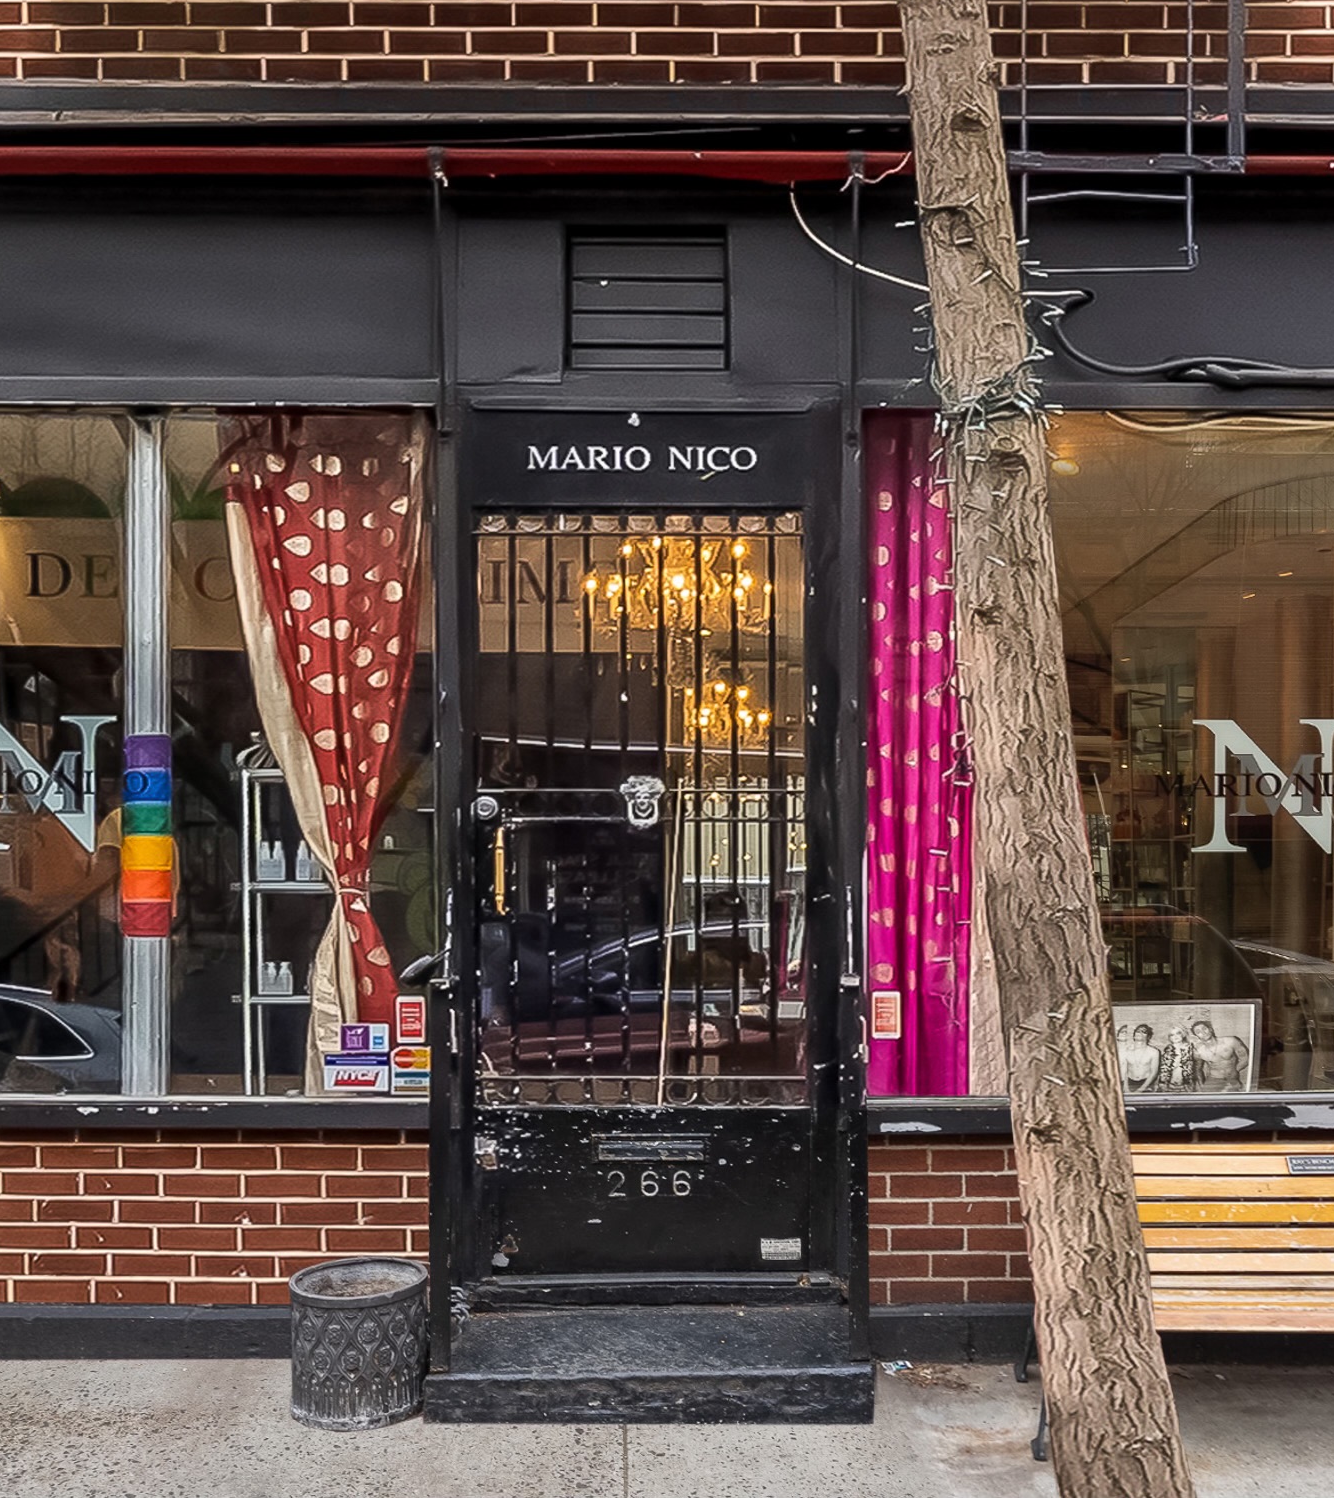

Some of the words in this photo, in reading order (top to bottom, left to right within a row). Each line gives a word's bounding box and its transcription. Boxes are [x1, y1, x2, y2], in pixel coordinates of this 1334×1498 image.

[526, 445, 651, 471] MARIO
[668, 446, 758, 471] NICO
[1154, 772, 1282, 797] MARIO
[607, 1170, 691, 1197] 266
